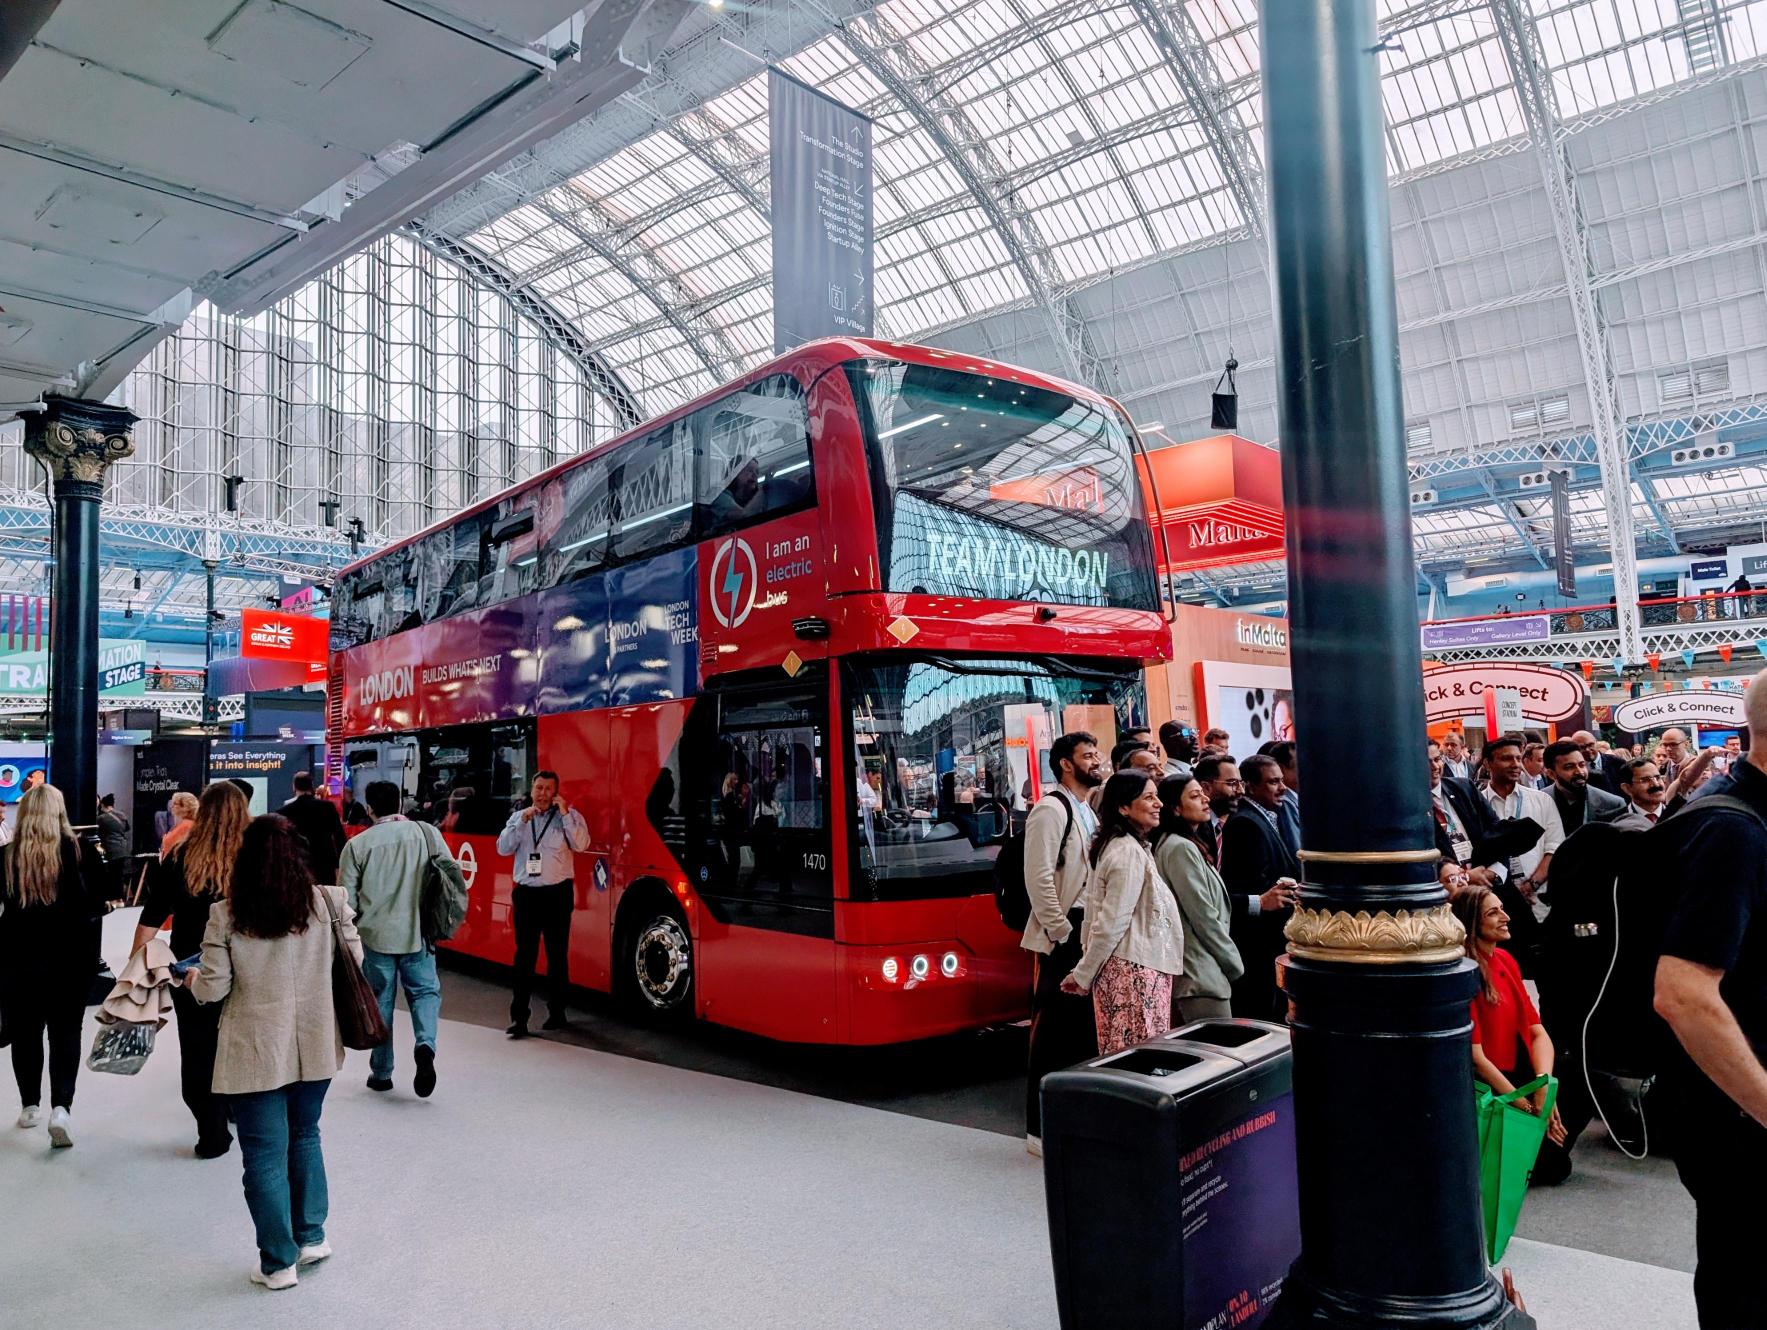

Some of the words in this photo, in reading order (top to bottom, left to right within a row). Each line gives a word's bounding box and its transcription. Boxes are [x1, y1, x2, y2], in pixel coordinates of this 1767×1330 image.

[800, 130, 846, 160] Transformation
[846, 153, 864, 169] Stage
[845, 142, 864, 158] Studio
[814, 180, 831, 196] Deep
[831, 187, 847, 202] Tech
[847, 195, 864, 211] Stage
[822, 195, 850, 215] Founders
[818, 205, 847, 225] Founders
[847, 217, 865, 232] Stage
[823, 218, 847, 235] Ignition
[848, 229, 865, 244] Stage
[827, 231, 850, 249] Startup
[850, 241, 865, 256] Alley
[834, 314, 846, 325] VIP
[846, 318, 866, 333] Village
[765, 541, 770, 560] I
[772, 540, 791, 558] am
[794, 535, 810, 552] an
[926, 532, 998, 578] TEAM
[1004, 541, 1109, 588] LONDON
[766, 558, 812, 584] electric
[663, 599, 689, 615] LONDON
[766, 590, 788, 606] bus
[604, 618, 647, 643] LONDON
[664, 612, 690, 631] TECH
[250, 633, 277, 644] GREAT
[671, 625, 699, 646] WEEK
[1238, 617, 1287, 648] inMalta
[616, 642, 638, 653] PARTNERS
[105, 663, 141, 688] STAGE
[422, 665, 448, 685] BUILDS
[448, 659, 479, 680] WHAT'S
[479, 654, 502, 673] NEXT
[360, 664, 415, 706] LONDON
[1453, 682, 1465, 697] &
[1469, 681, 1549, 702] Cect
[1634, 705, 1664, 720] Click
[1667, 703, 1676, 713] &
[1679, 702, 1735, 715] Connect
[216, 761, 223, 769] it
[225, 761, 244, 769] into
[246, 760, 281, 770] insight!
[228, 751, 243, 760] See
[245, 751, 286, 761] Everything
[149, 780, 165, 794] Crystal
[802, 853, 826, 871] 1470
[1232, 1124, 1246, 1141] AND
[1246, 1110, 1276, 1135] RUBBISH
[1200, 1182, 1208, 1193] and
